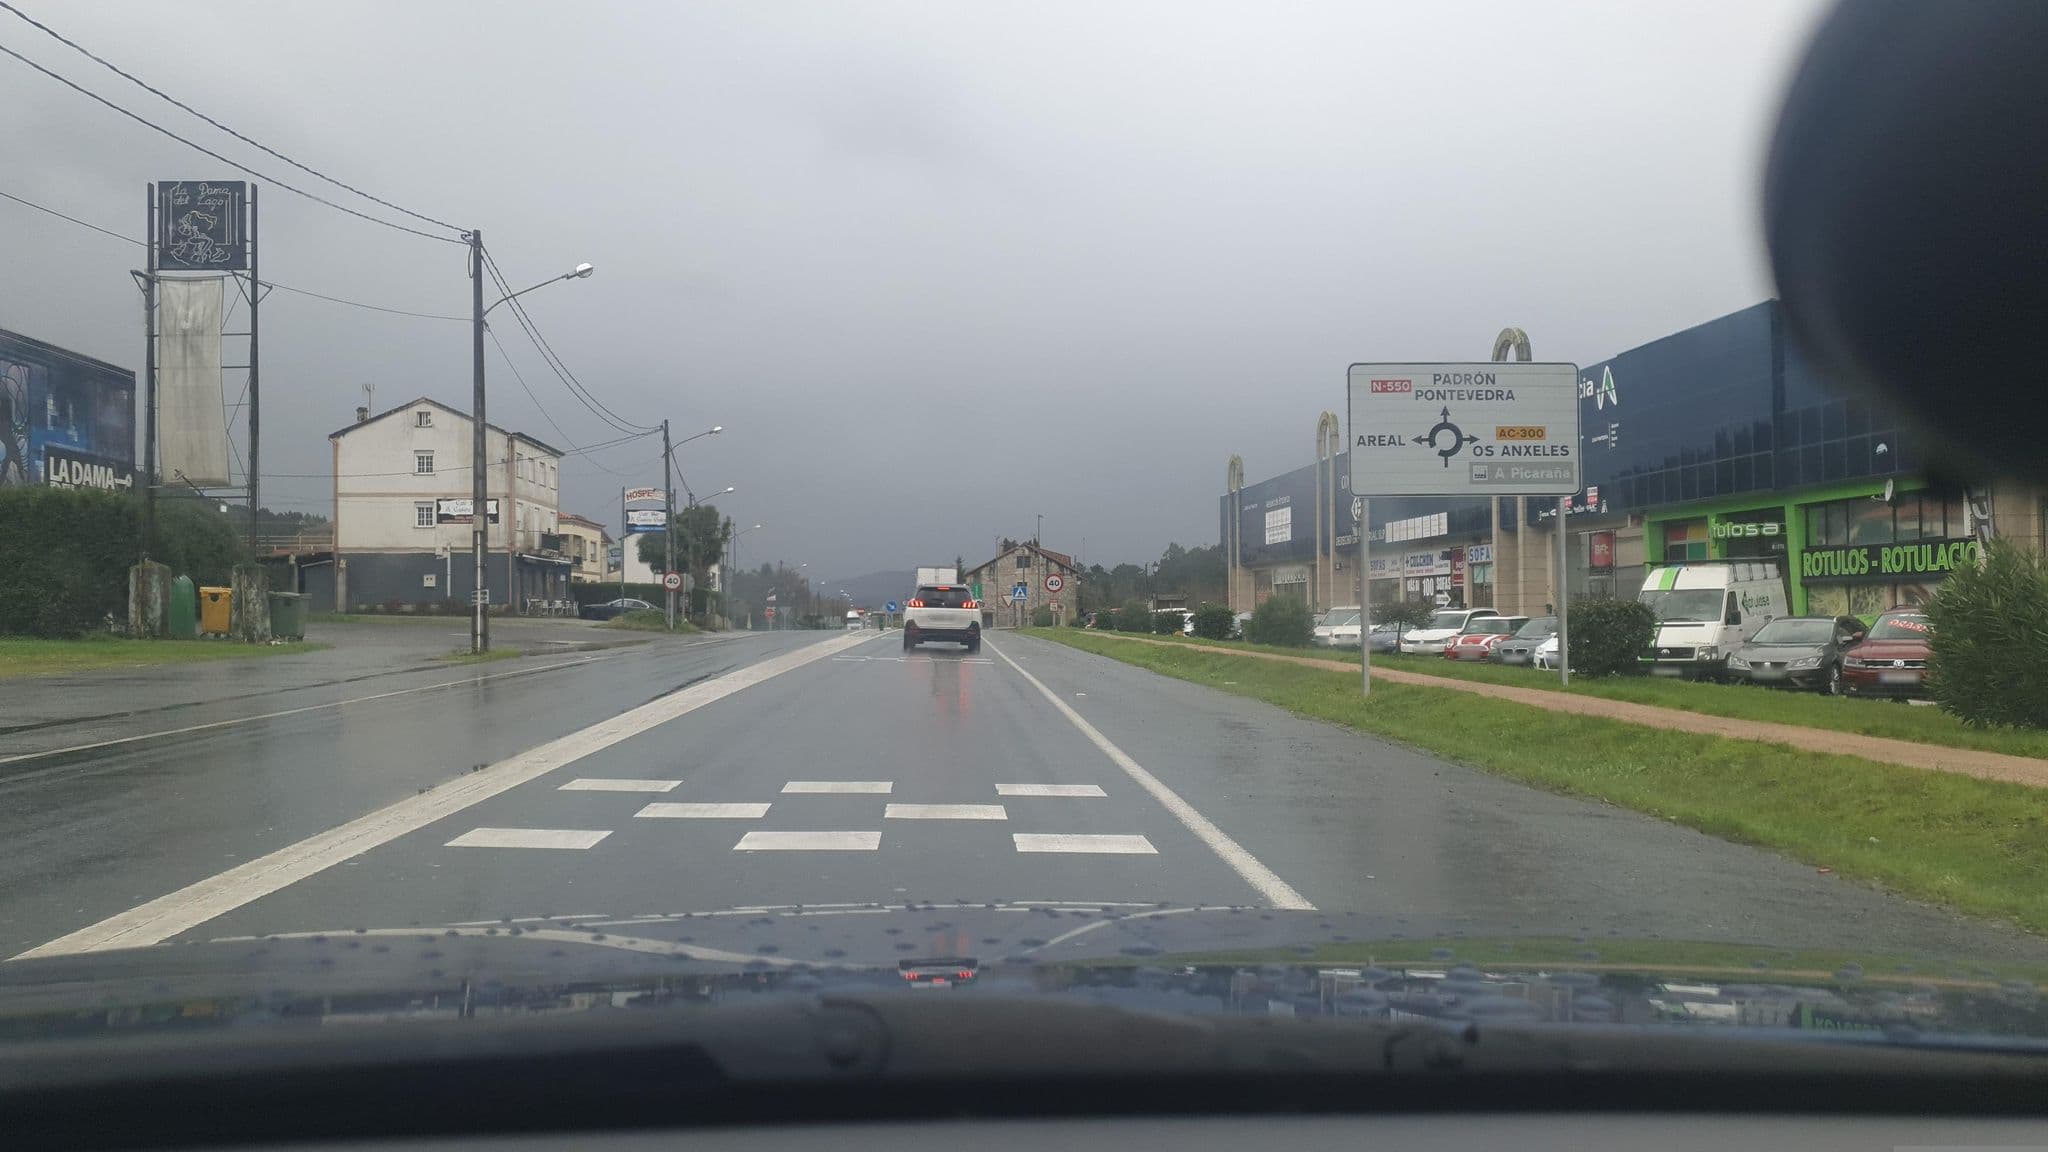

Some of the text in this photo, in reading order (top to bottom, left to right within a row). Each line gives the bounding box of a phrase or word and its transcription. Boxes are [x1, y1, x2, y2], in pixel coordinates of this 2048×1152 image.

[199, 182, 230, 195] Dama
[197, 195, 224, 211] Lago
[1433, 371, 1496, 385] PADRÓN
[1372, 381, 1410, 392] N-550
[1415, 389, 1515, 401] PONTEVEDRA
[1499, 429, 1544, 438] AC-300
[1357, 435, 1406, 447] AREAL
[1473, 445, 1570, 457] OS ANXELES
[49, 456, 115, 490] LA DAMA
[1495, 467, 1570, 479] A Picaraña
[626, 489, 655, 501] HOSPE
[1803, 548, 1870, 577] ROTULOS
[1422, 577, 1434, 597] 100
